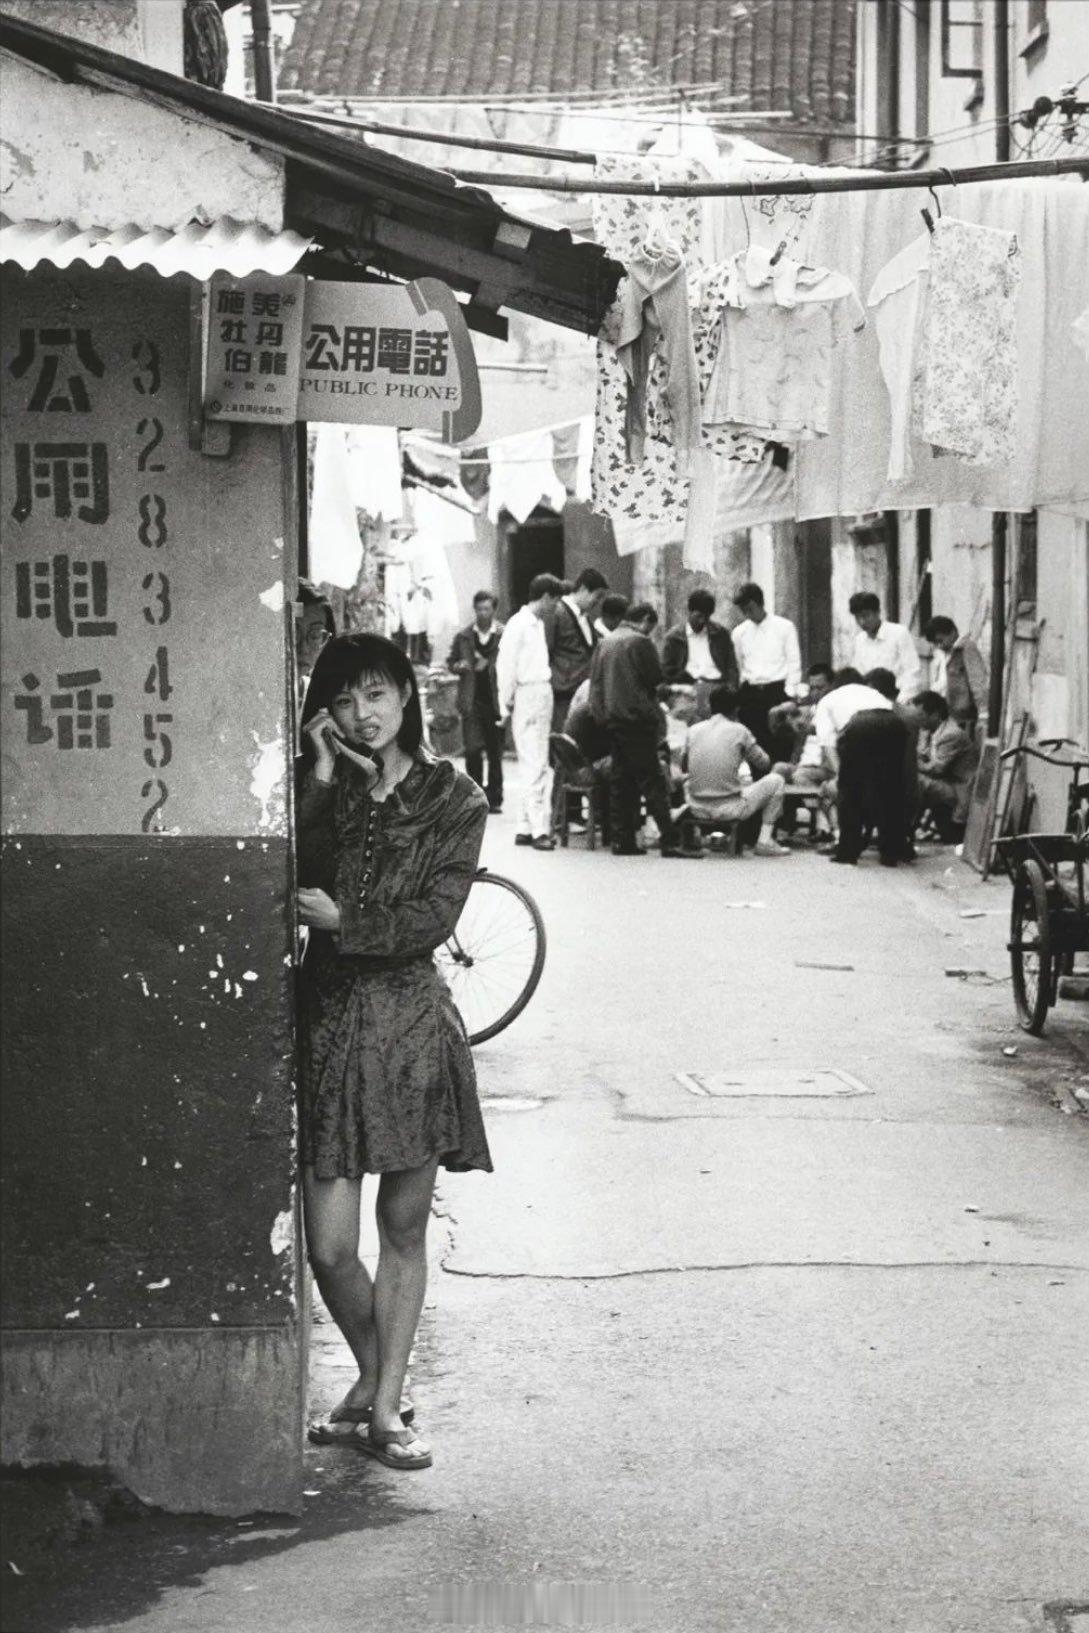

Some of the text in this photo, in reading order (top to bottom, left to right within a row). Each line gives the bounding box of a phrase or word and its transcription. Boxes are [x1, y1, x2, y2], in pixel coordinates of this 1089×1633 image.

[220, 319, 284, 346] 牡丹
[305, 323, 449, 377] 公用電話
[300, 378, 458, 401] PUBLIC PHONE
[8, 328, 118, 750] 公用电话
[132, 341, 174, 833] 3283452
